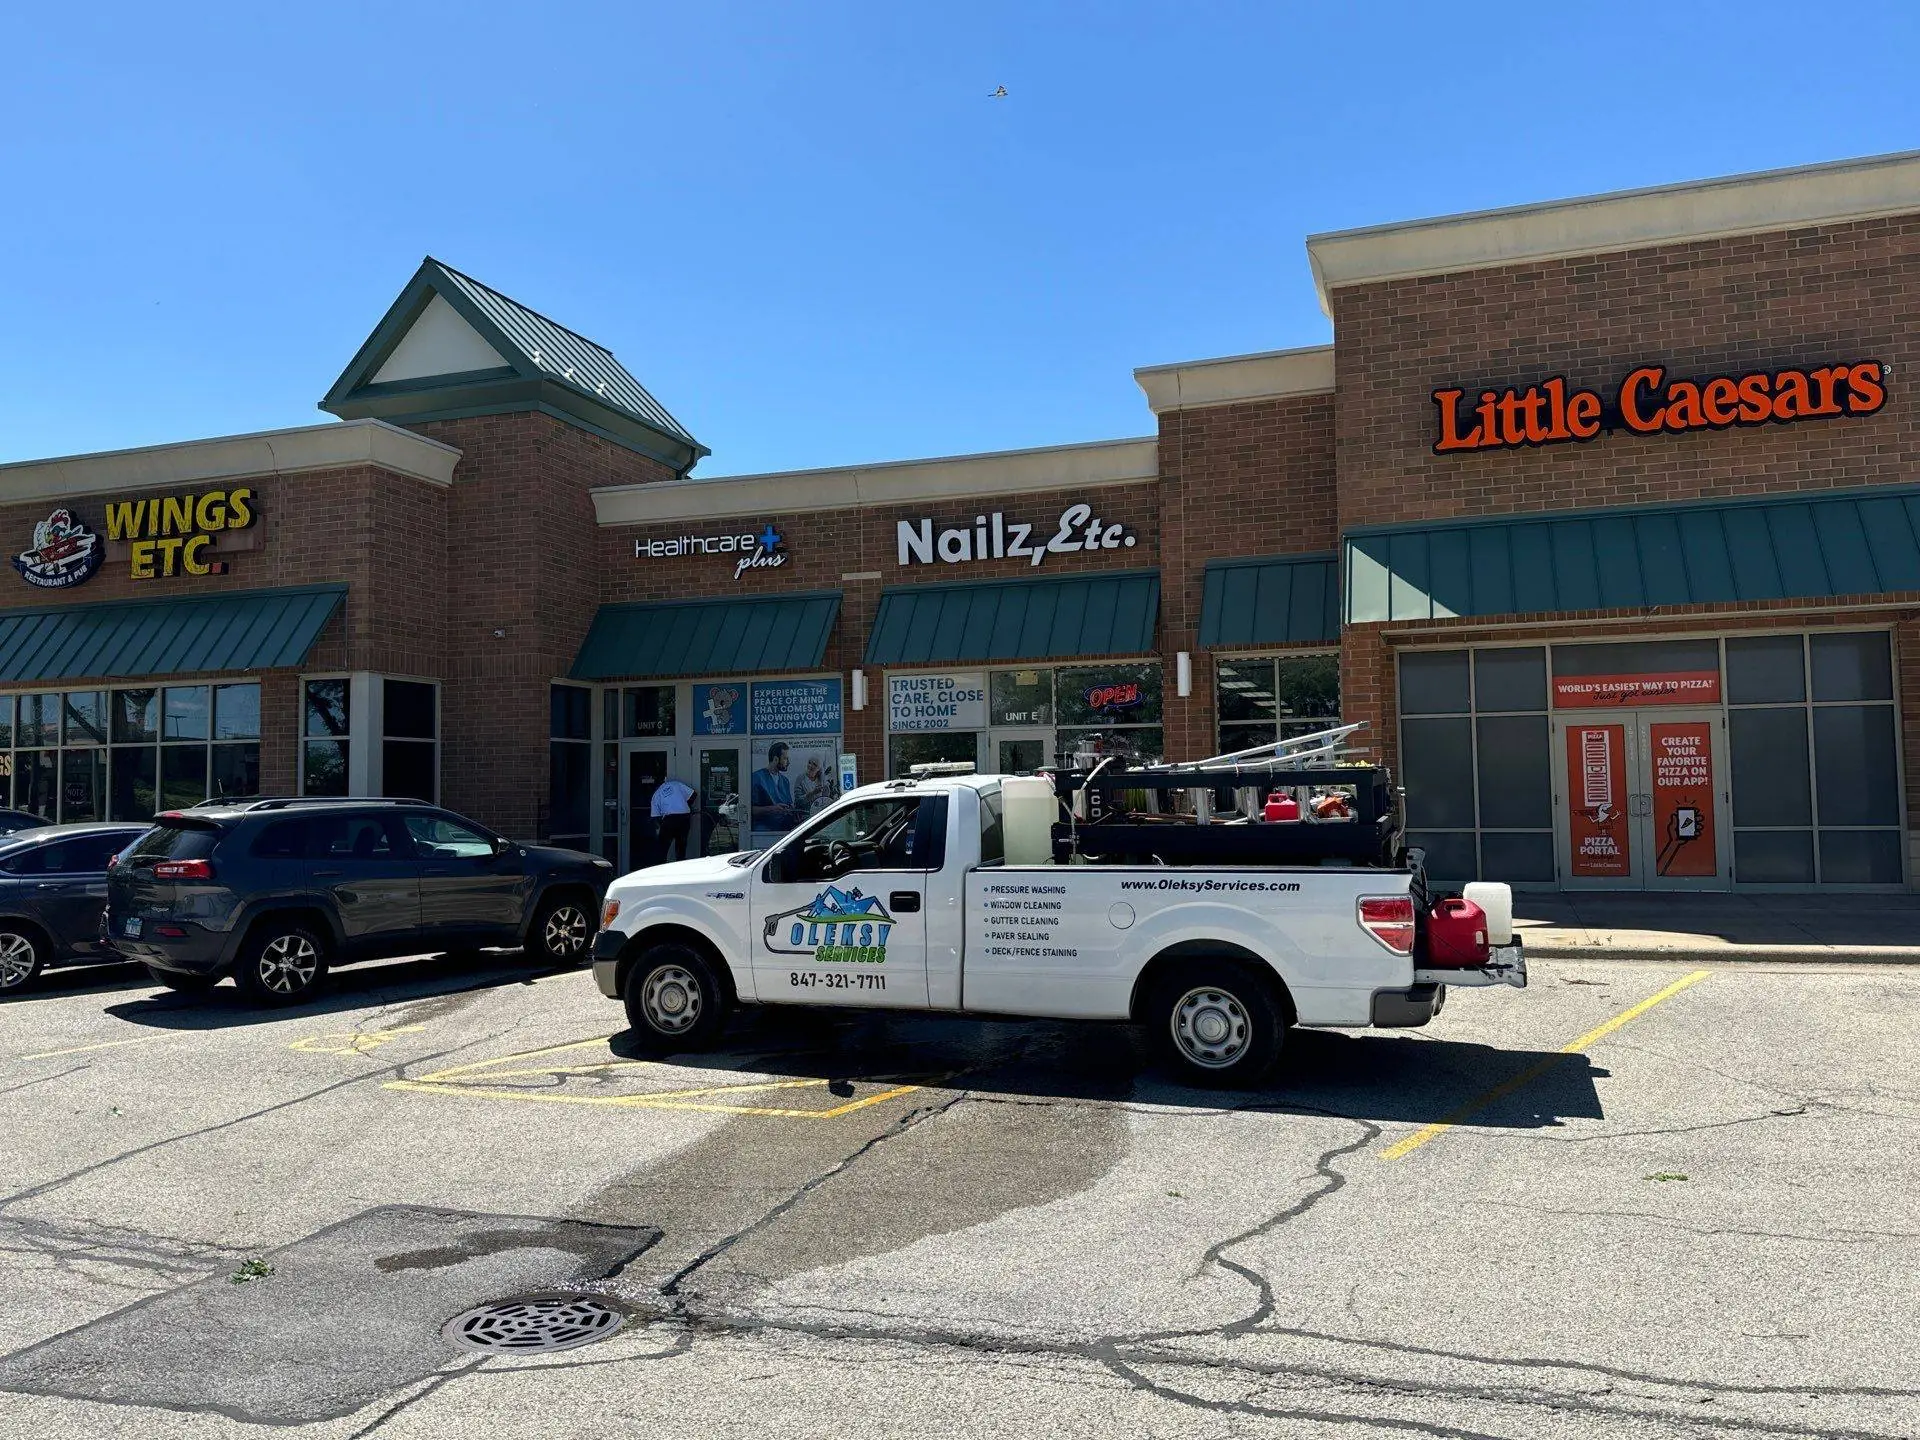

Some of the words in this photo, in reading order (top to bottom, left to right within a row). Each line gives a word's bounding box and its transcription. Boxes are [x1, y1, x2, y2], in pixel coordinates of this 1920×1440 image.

[1434, 374, 1601, 451] Little
[1619, 362, 1885, 433] Caesars
[105, 488, 252, 540] WINGS
[1046, 503, 1136, 553] Etc.
[635, 533, 755, 558] Healthcare
[130, 535, 223, 580] ETC.
[733, 546, 787, 580] plus
[24, 571, 66, 586] RESTAURANT
[74, 564, 88, 580] PUB
[892, 677, 954, 691] TRUSTED
[1558, 683, 1600, 693] WORLD'S
[1602, 682, 1640, 692] EASIEST
[1642, 681, 1664, 690] WAY
[1666, 681, 1678, 689] TO
[1680, 680, 1712, 688] PIZZA!
[754, 688, 808, 698] EXPERIENCE
[811, 687, 828, 696] THE
[892, 692, 934, 707] CARE,
[938, 688, 984, 702] CLOSE
[1089, 683, 1138, 708] OPEN
[754, 698, 784, 706] PEACE
[780, 704, 813, 712] COMES
[816, 703, 840, 711] WITH
[892, 706, 912, 718] TO
[915, 704, 957, 717] HOME
[754, 713, 800, 722] KNOWING
[800, 712, 819, 720] YOU
[822, 712, 840, 720] ARE
[1006, 712, 1027, 722] UNIT
[1032, 712, 1038, 720] E
[637, 721, 656, 730] UNIT
[766, 722, 794, 730] GOOD
[796, 720, 828, 728] HANDS
[892, 720, 923, 730] SINCE
[924, 719, 949, 728] 2002
[1662, 736, 1700, 746] CREATE
[1666, 747, 1696, 756] YOUR
[1657, 756, 1707, 766] FAVORITE
[1658, 767, 1688, 776] PIZZA
[1691, 766, 1706, 776] ON
[1658, 777, 1680, 786] OUR
[1684, 776, 1708, 786] APP!
[1584, 837, 1614, 846] PIZZA
[1580, 846, 1620, 854] PORTAL
[990, 886, 1029, 894] PRESSURE
[1032, 886, 1066, 894] WASHING
[1120, 879, 1300, 892] www.OleksyServices.com
[990, 902, 1021, 910] WINDOW
[1024, 902, 1062, 910] CLEANING
[990, 916, 1019, 925] GUTTER
[1021, 917, 1059, 926] CLEANING
[790, 922, 892, 947] OLEKSY
[991, 932, 1015, 940] PAVER
[1018, 932, 1050, 940] SEALING
[815, 946, 886, 963] SERVICES
[992, 947, 1040, 956] DECK/FENCE
[1042, 948, 1078, 957] STAINING
[790, 972, 886, 990] 847-321-7711
